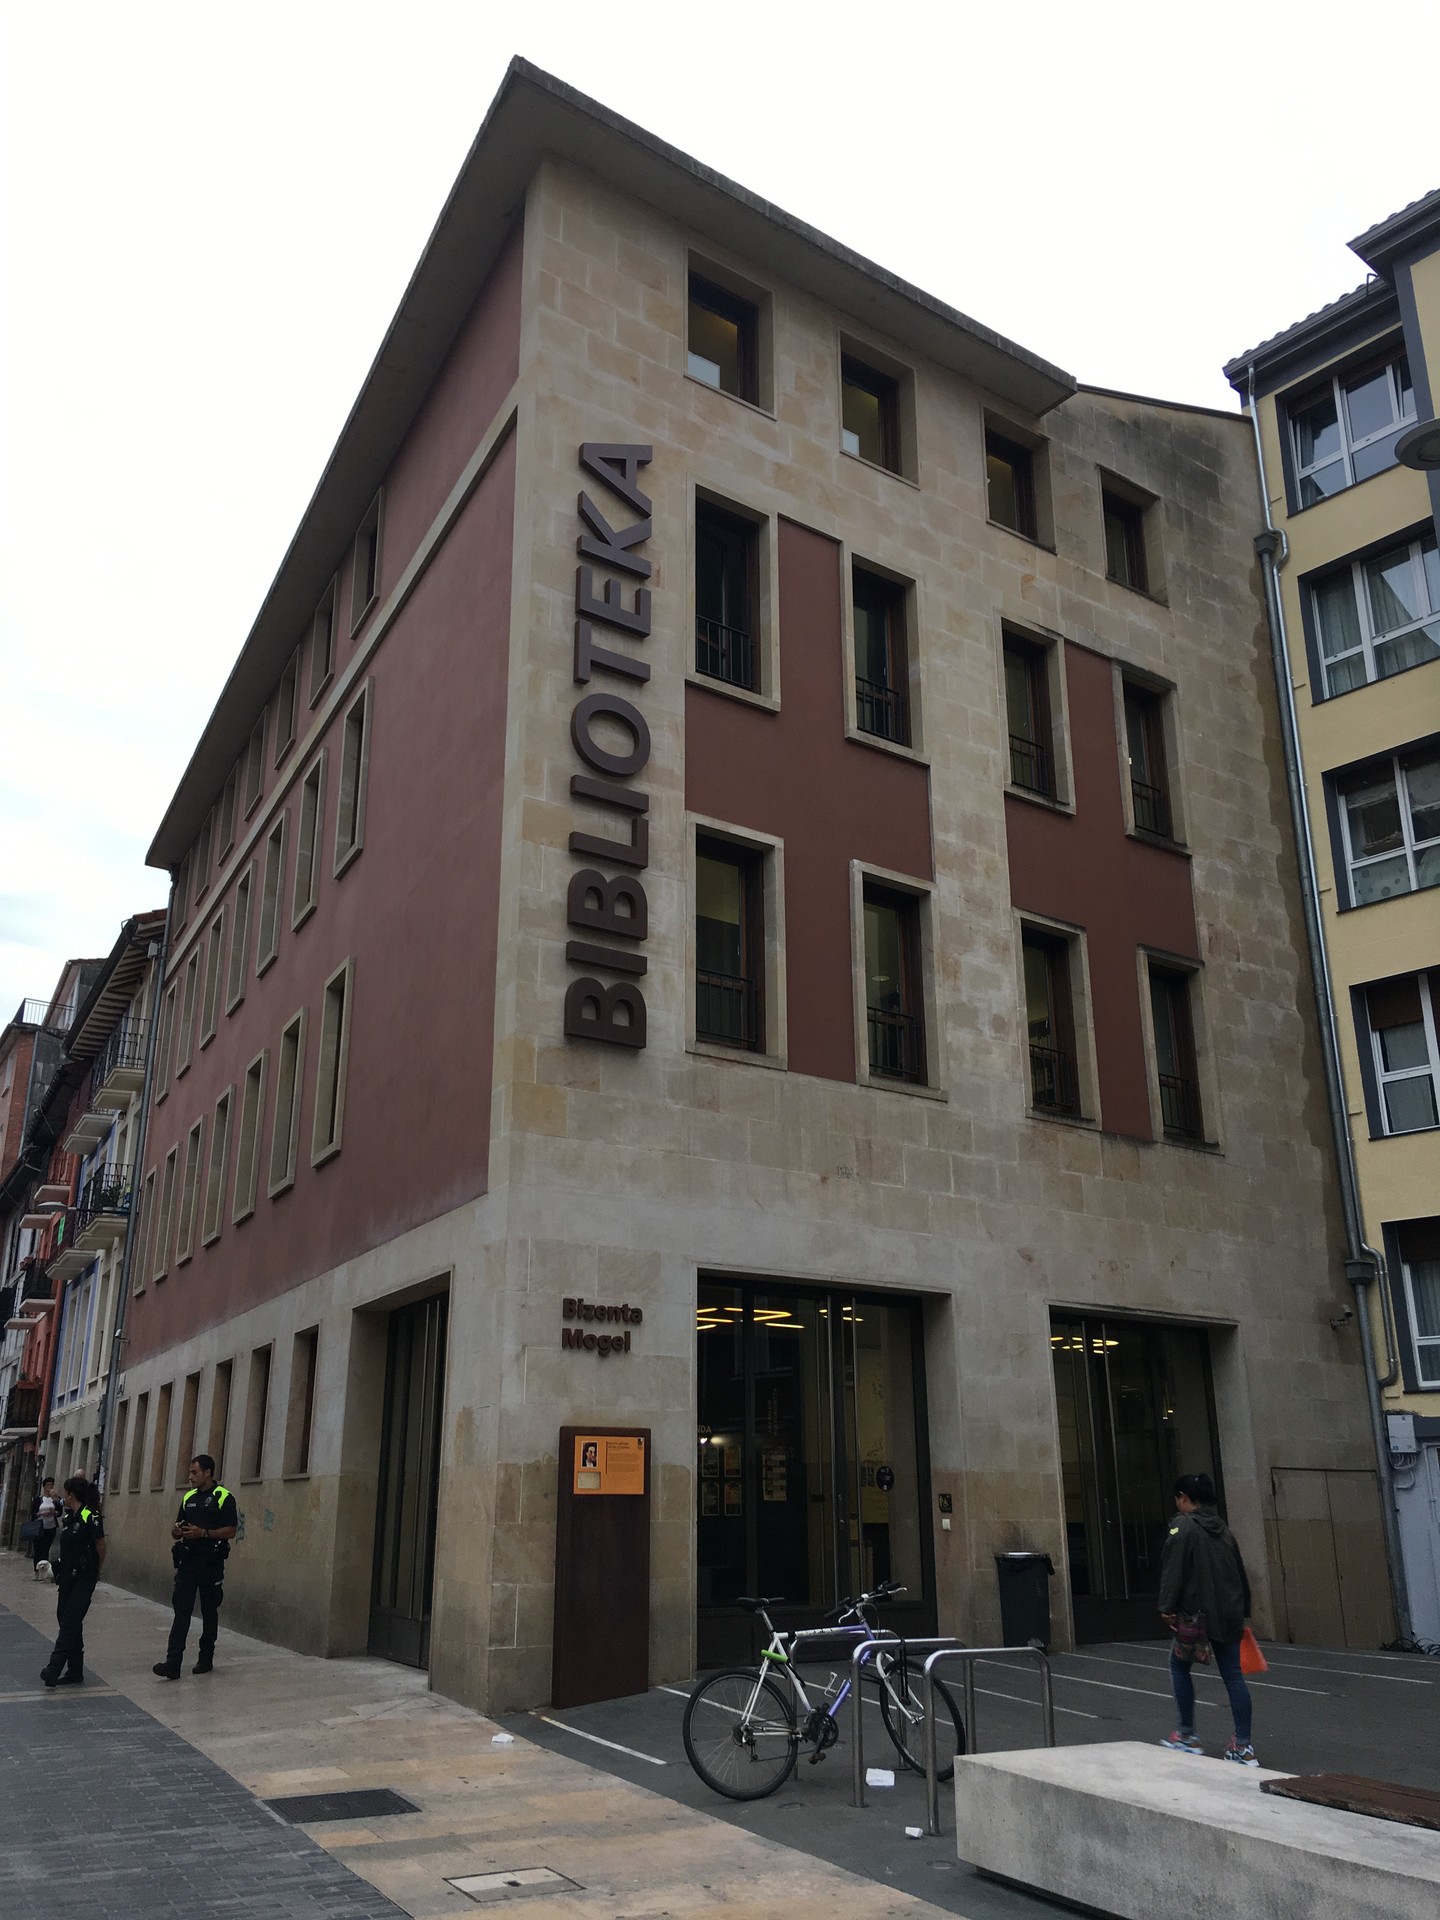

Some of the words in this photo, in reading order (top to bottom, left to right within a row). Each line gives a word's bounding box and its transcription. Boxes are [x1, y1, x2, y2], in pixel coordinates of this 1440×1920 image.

[564, 443, 653, 1050] BIBLIOTEKA
[562, 1298, 643, 1323] Bizenta
[561, 1328, 631, 1358] Mogel
